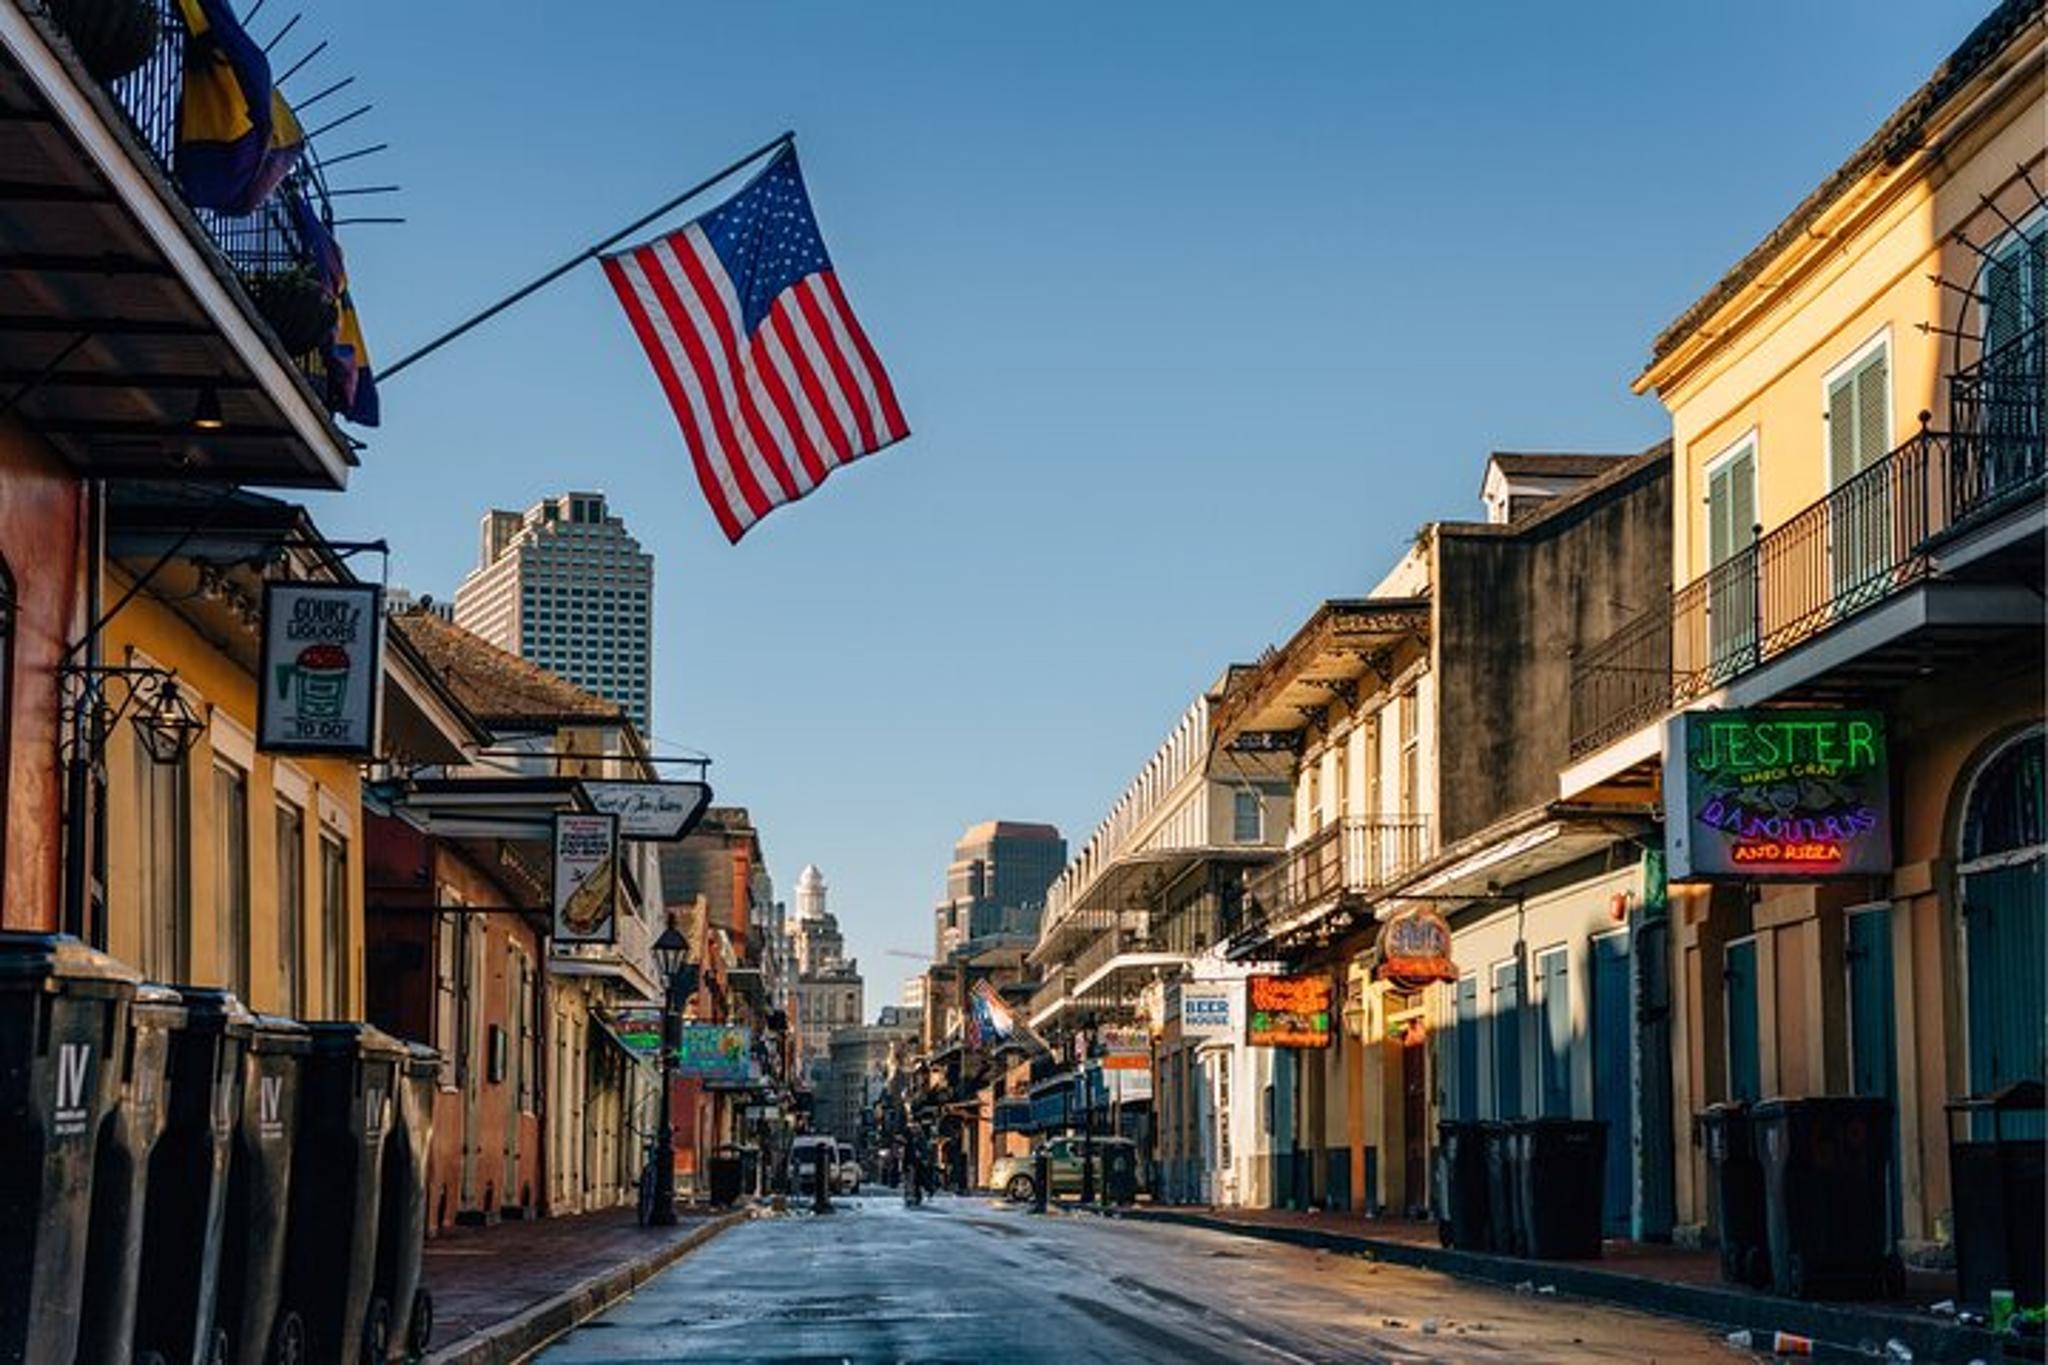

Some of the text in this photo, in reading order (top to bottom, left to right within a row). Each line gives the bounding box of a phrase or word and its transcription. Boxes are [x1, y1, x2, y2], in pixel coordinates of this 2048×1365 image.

[293, 597, 350, 623] COURT
[1698, 721, 1876, 770] JESTER
[1735, 843, 1842, 860] AND PIZZA
[1185, 1000, 1230, 1013] BEER
[1185, 1015, 1228, 1025] HOUSE
[56, 1043, 90, 1108] IV
[260, 1075, 283, 1121] IV
